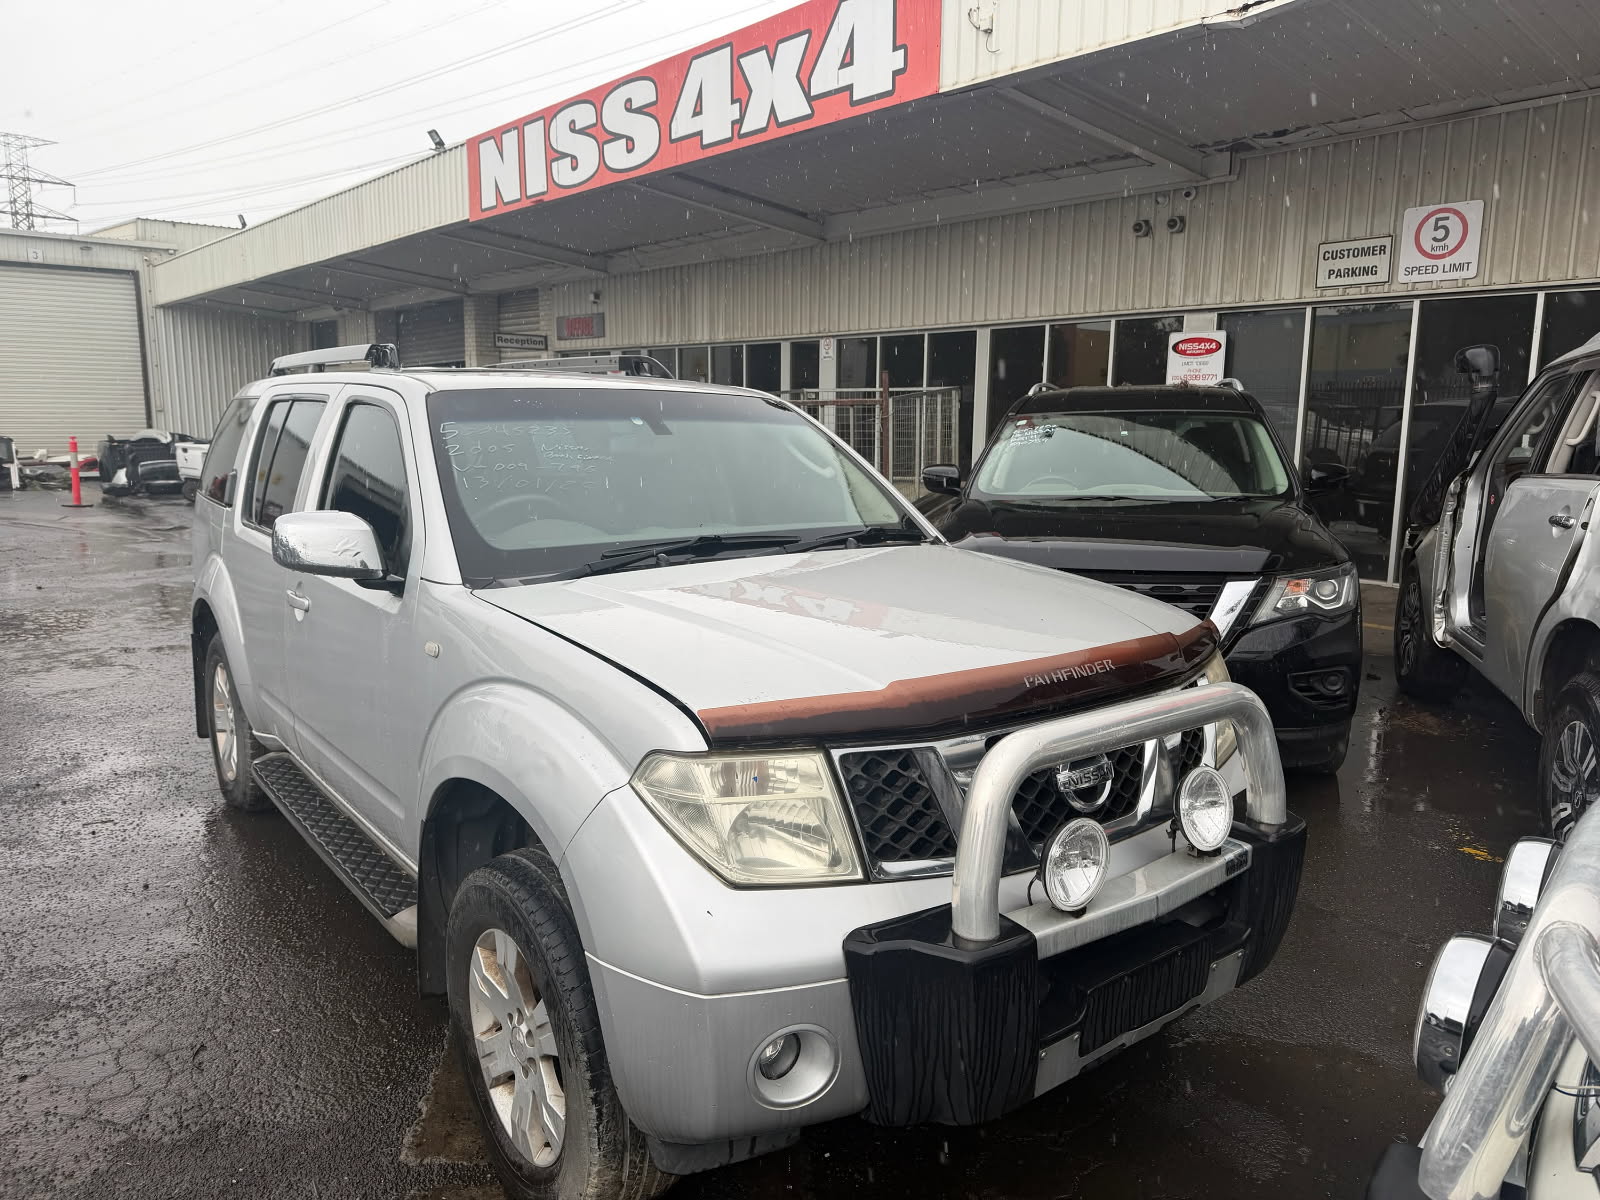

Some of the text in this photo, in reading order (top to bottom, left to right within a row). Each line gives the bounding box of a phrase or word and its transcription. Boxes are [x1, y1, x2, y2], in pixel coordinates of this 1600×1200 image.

[1431, 216, 1450, 243] 5
[1322, 244, 1387, 261] CUSTOMER
[1430, 243, 1449, 253] kmh
[1327, 264, 1378, 280] PARKING
[1403, 261, 1473, 277] SPEED LIMIT
[496, 335, 544, 347] Reception
[1178, 342, 1217, 350] NISS4X4
[1023, 658, 1116, 688] PATHFINDER
[1068, 762, 1113, 787] NISSAN
